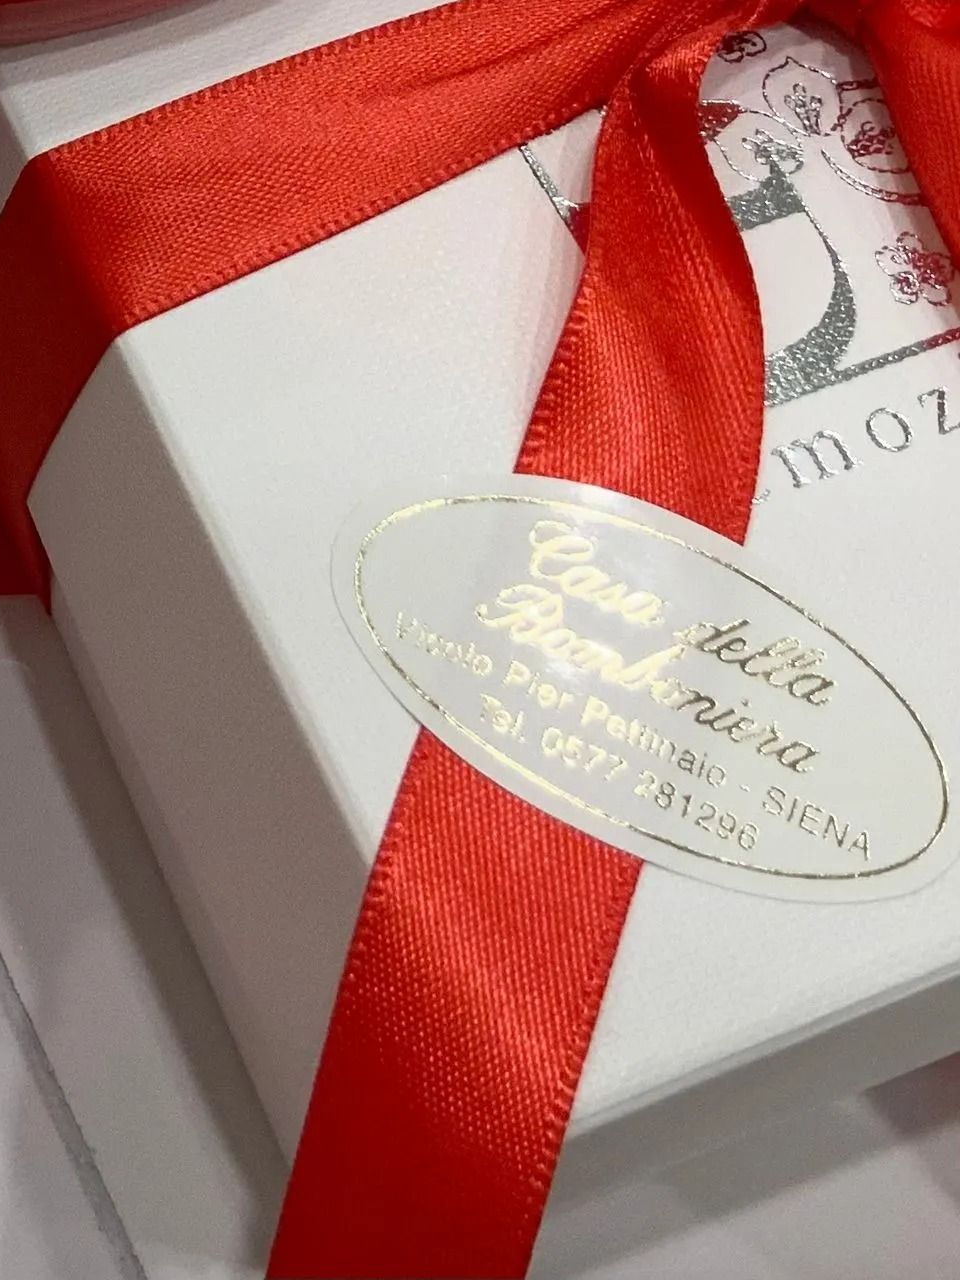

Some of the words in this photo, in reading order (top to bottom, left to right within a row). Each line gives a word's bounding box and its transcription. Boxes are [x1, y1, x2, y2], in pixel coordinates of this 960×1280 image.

[751, 386, 960, 506] moz
[529, 521, 670, 627] Casa
[673, 619, 837, 707] della
[479, 692, 527, 745] Tel.
[541, 726, 630, 783] 0577
[633, 767, 761, 852] 281296
[501, 658, 575, 712] Pier
[761, 785, 873, 862] SIENA
